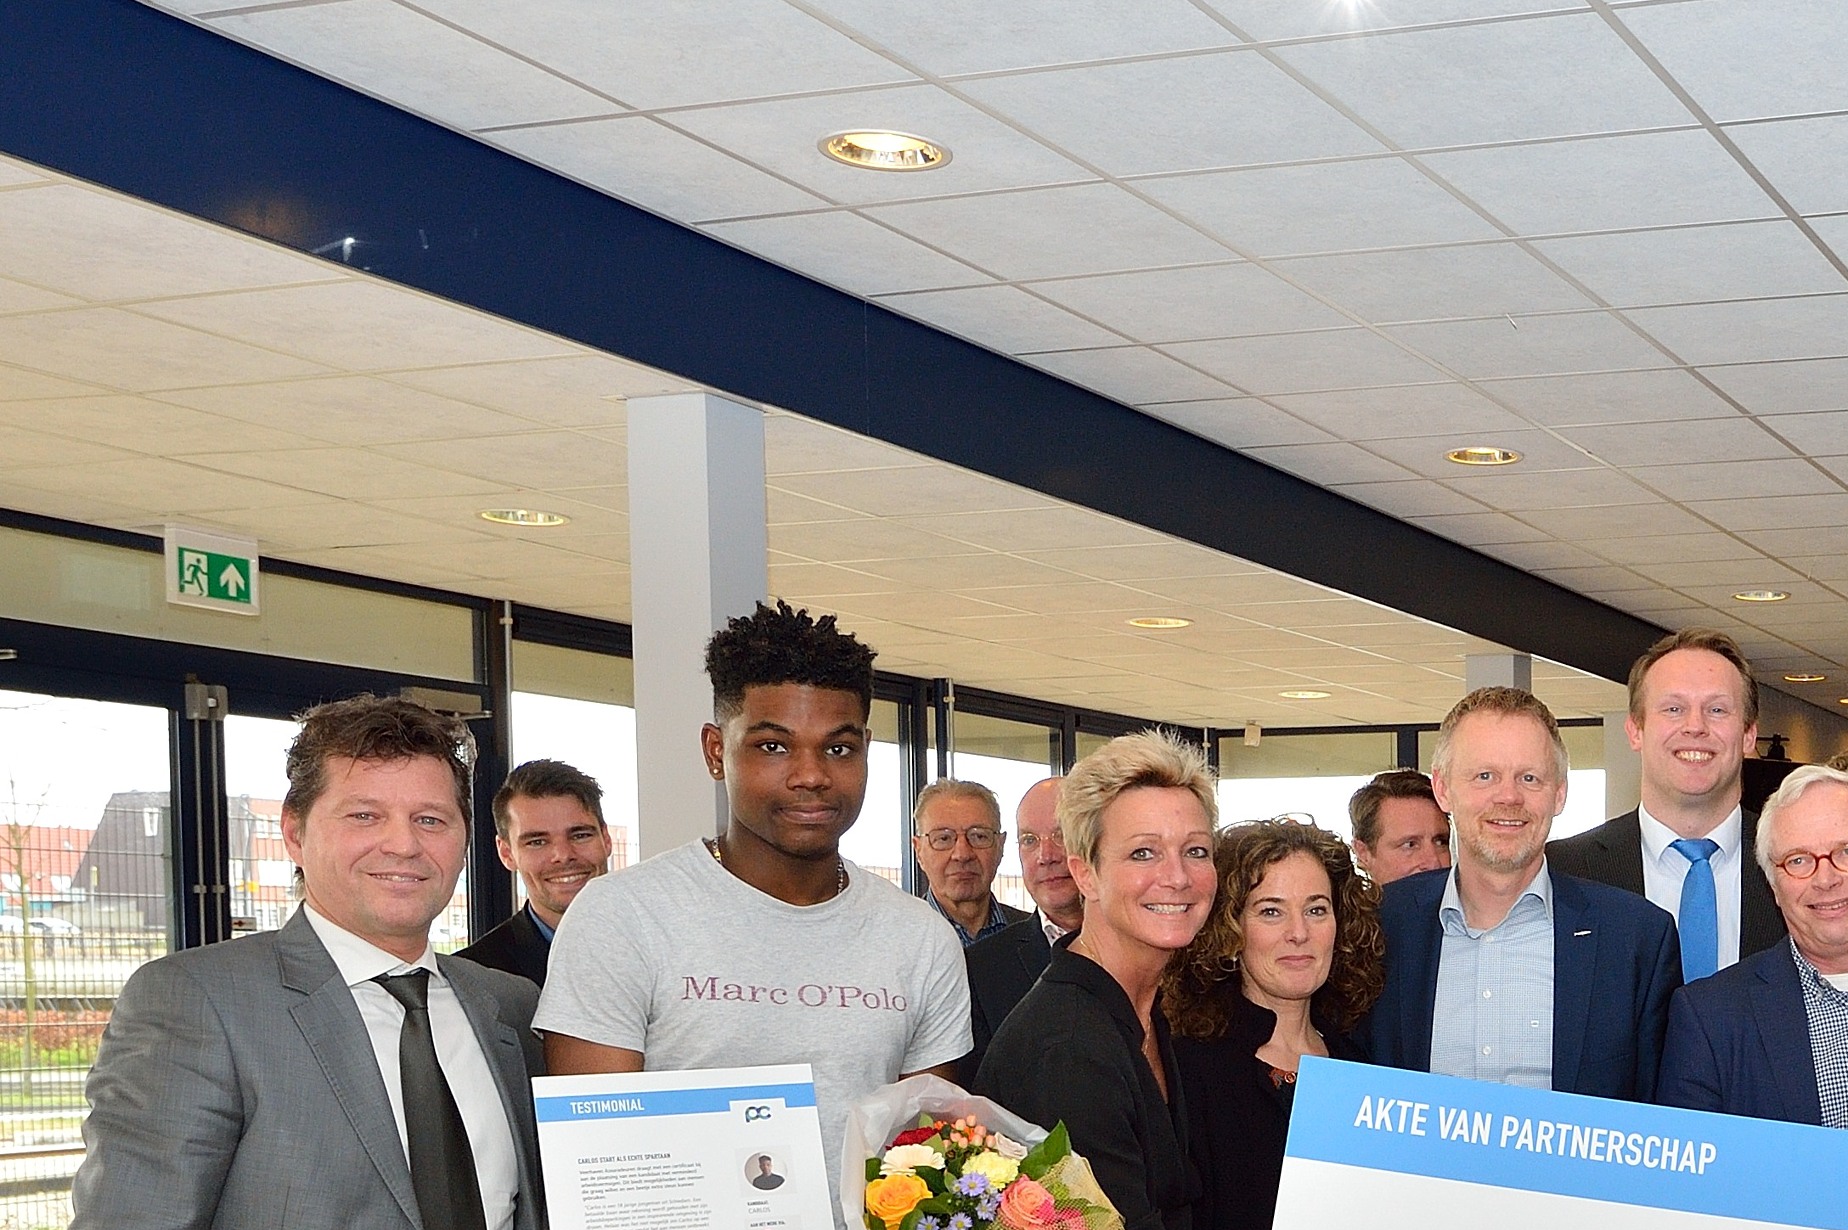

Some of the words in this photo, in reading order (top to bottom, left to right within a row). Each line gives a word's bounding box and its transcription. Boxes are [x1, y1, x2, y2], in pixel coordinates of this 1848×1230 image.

[681, 976, 788, 1005] Marc
[797, 984, 908, 1012] O'Polo
[570, 1099, 644, 1114] TESTIMONIAL
[1353, 1094, 1430, 1136] AKTE
[1438, 1105, 1492, 1145] VAN
[1499, 1115, 1716, 1174] PARTNERSCHAP
